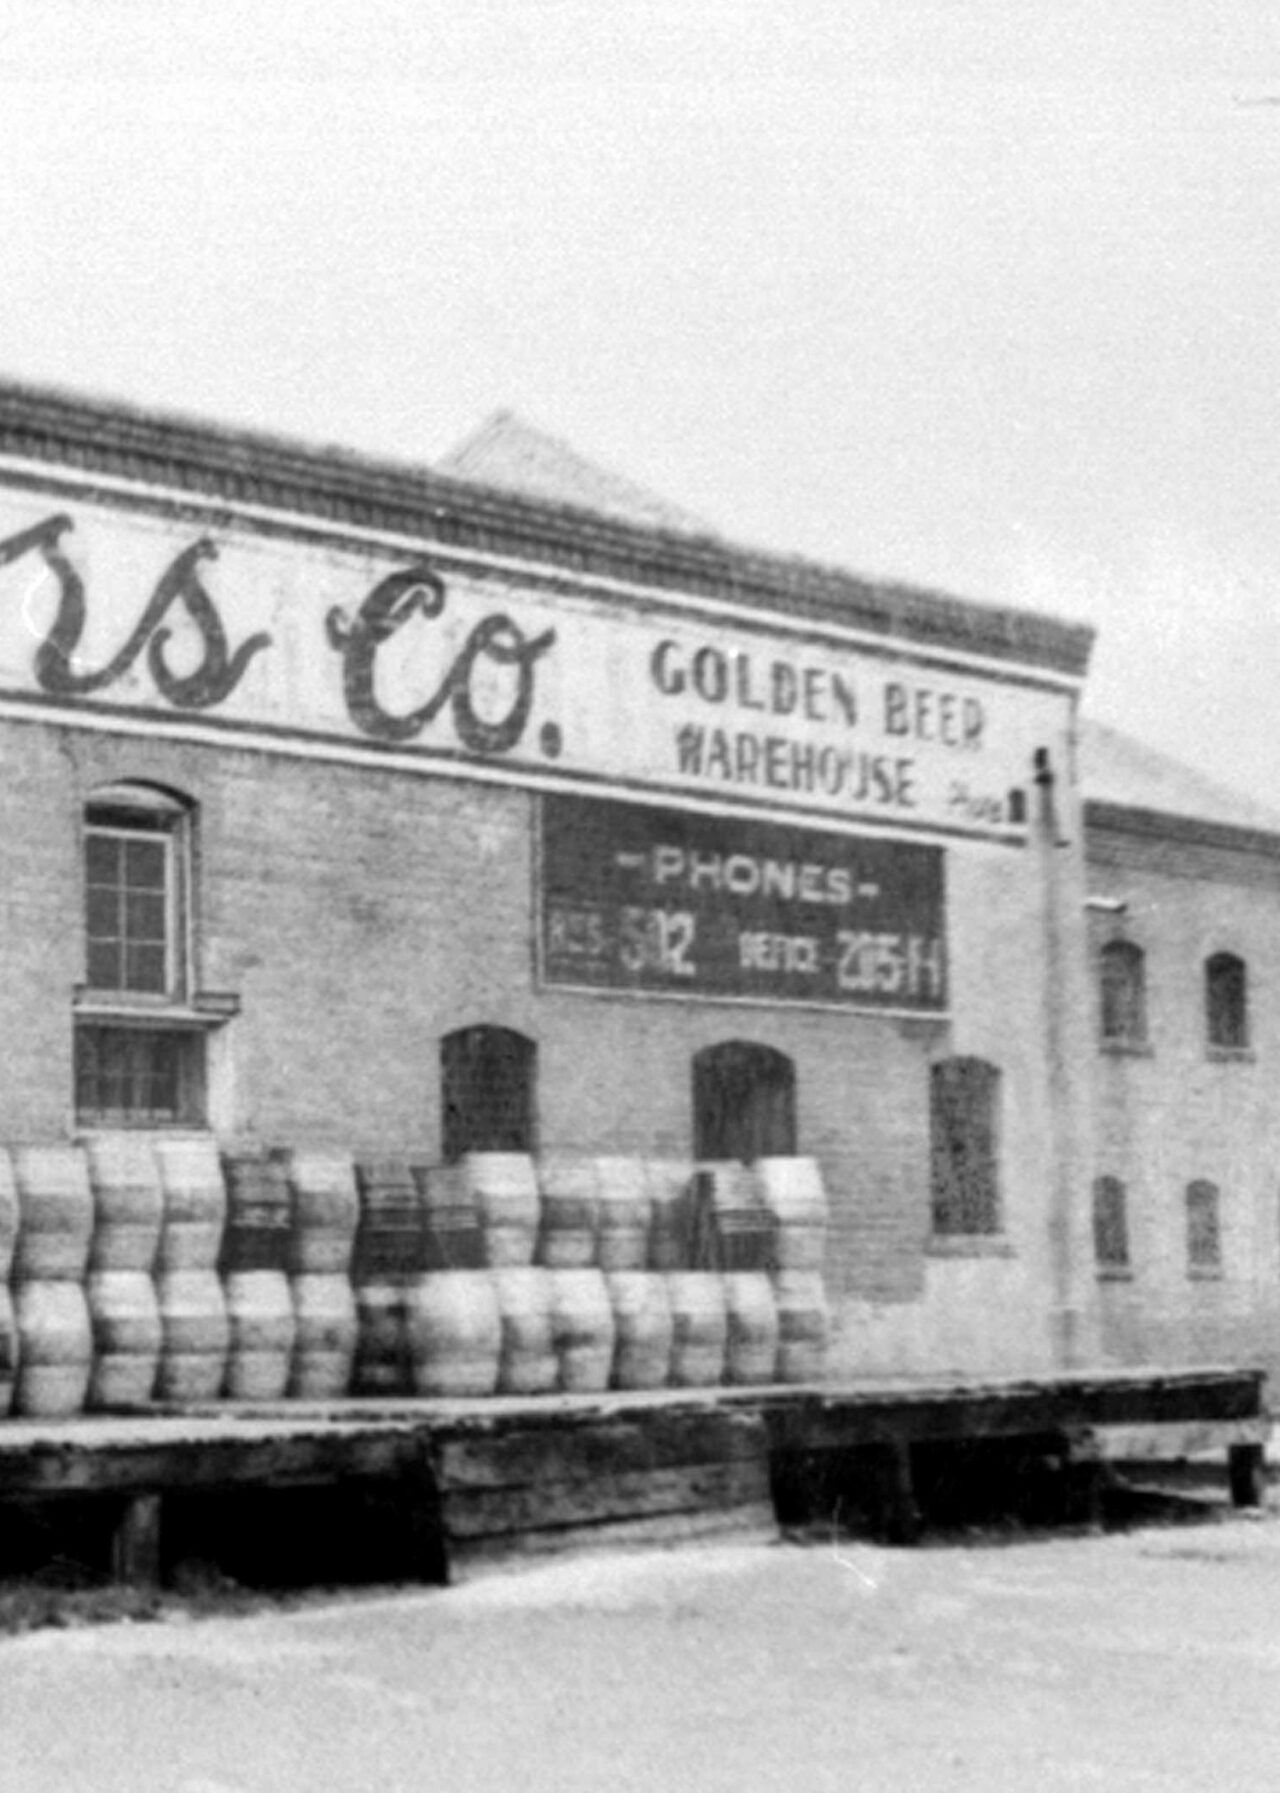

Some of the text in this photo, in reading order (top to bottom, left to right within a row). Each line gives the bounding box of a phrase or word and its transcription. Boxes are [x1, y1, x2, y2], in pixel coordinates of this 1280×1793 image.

[324, 566, 563, 766] Co.
[649, 638, 986, 750] GOLDEN BEER
[675, 722, 917, 808] WAREHOUSE
